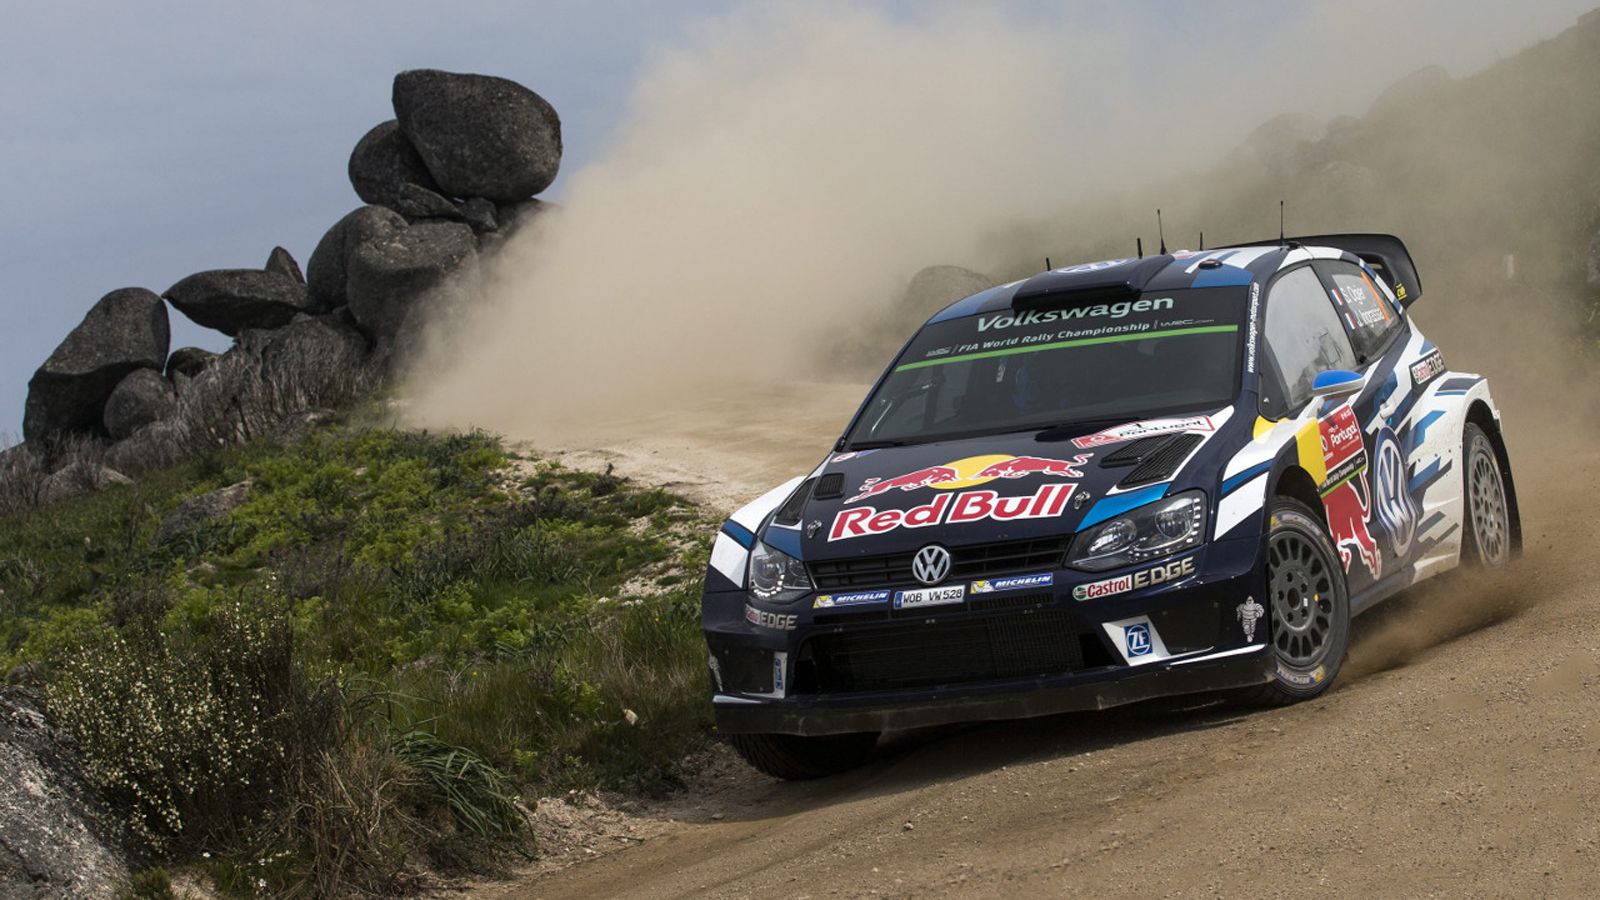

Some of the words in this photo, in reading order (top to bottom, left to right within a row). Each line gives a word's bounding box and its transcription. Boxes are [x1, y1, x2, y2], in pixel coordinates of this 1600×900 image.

[977, 297, 1174, 332] Volkswagen
[958, 343, 979, 353] FIA
[983, 337, 1019, 349] World
[1021, 330, 1055, 344] Rally
[1057, 322, 1150, 340] Championship
[828, 492, 949, 542] Red
[945, 483, 1079, 524] Bull
[994, 575, 1051, 587] MICHELIN
[1087, 577, 1131, 598] Castrol
[1134, 556, 1196, 589] EDGE
[836, 591, 888, 602] MICHELIN
[903, 593, 922, 604] WOB
[761, 611, 799, 630] EDGE
[1128, 629, 1150, 650] ZF
